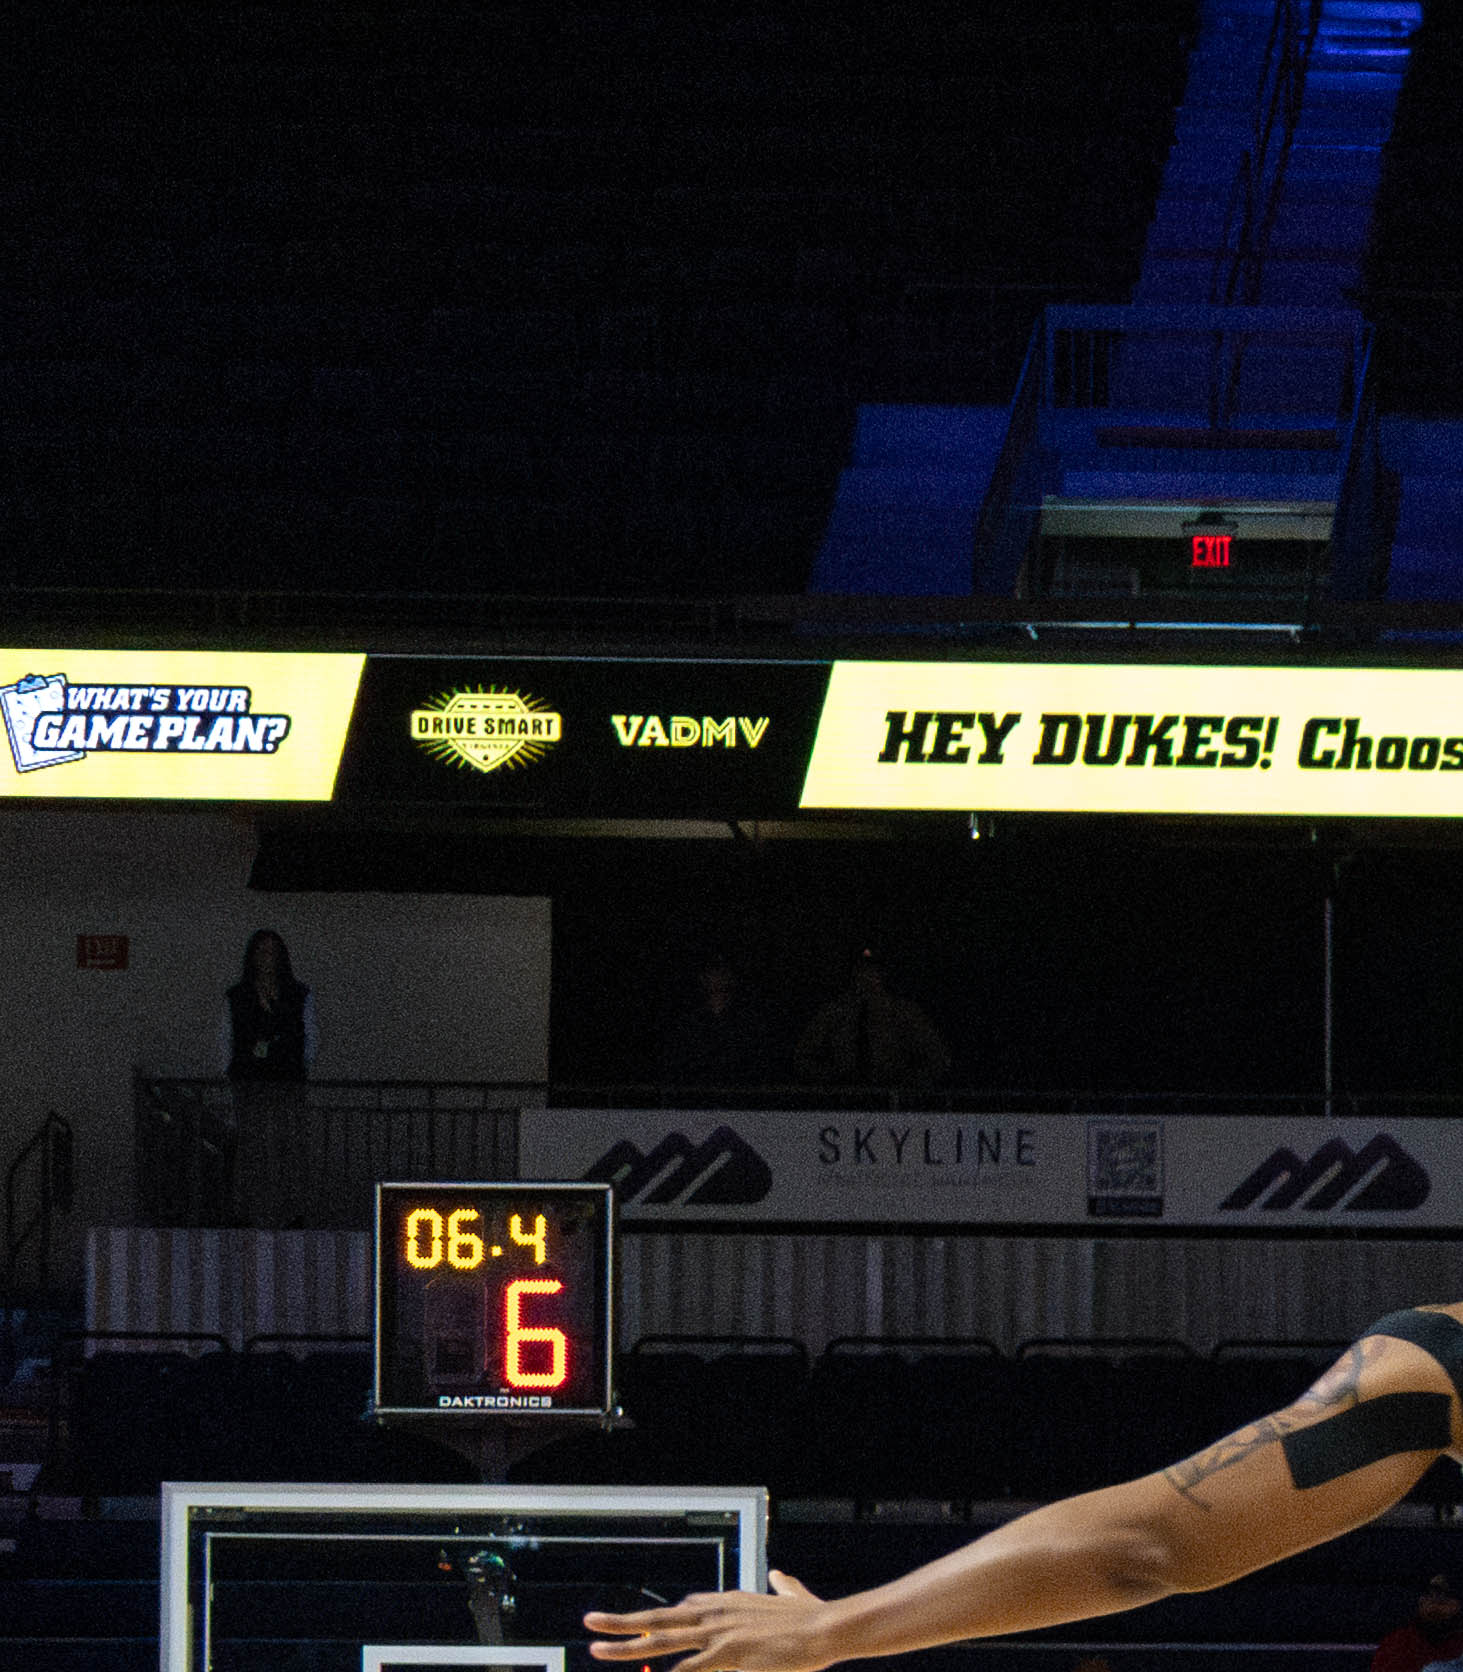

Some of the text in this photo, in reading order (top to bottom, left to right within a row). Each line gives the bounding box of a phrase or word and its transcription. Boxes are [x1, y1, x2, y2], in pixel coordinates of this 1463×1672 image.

[1191, 536, 1231, 567] EXIT
[69, 688, 248, 712] WHAT'S YOUR
[34, 714, 288, 752] GAME PLAN?
[418, 716, 554, 735] DRIVE SMART
[879, 711, 1021, 765] HEY
[1034, 713, 1280, 770] DUKES!
[817, 1125, 1038, 1169] SKYLINE
[406, 1208, 547, 1270] 06.4
[505, 1278, 567, 1390] 6
[439, 1396, 552, 1408] DAKTRONICS
